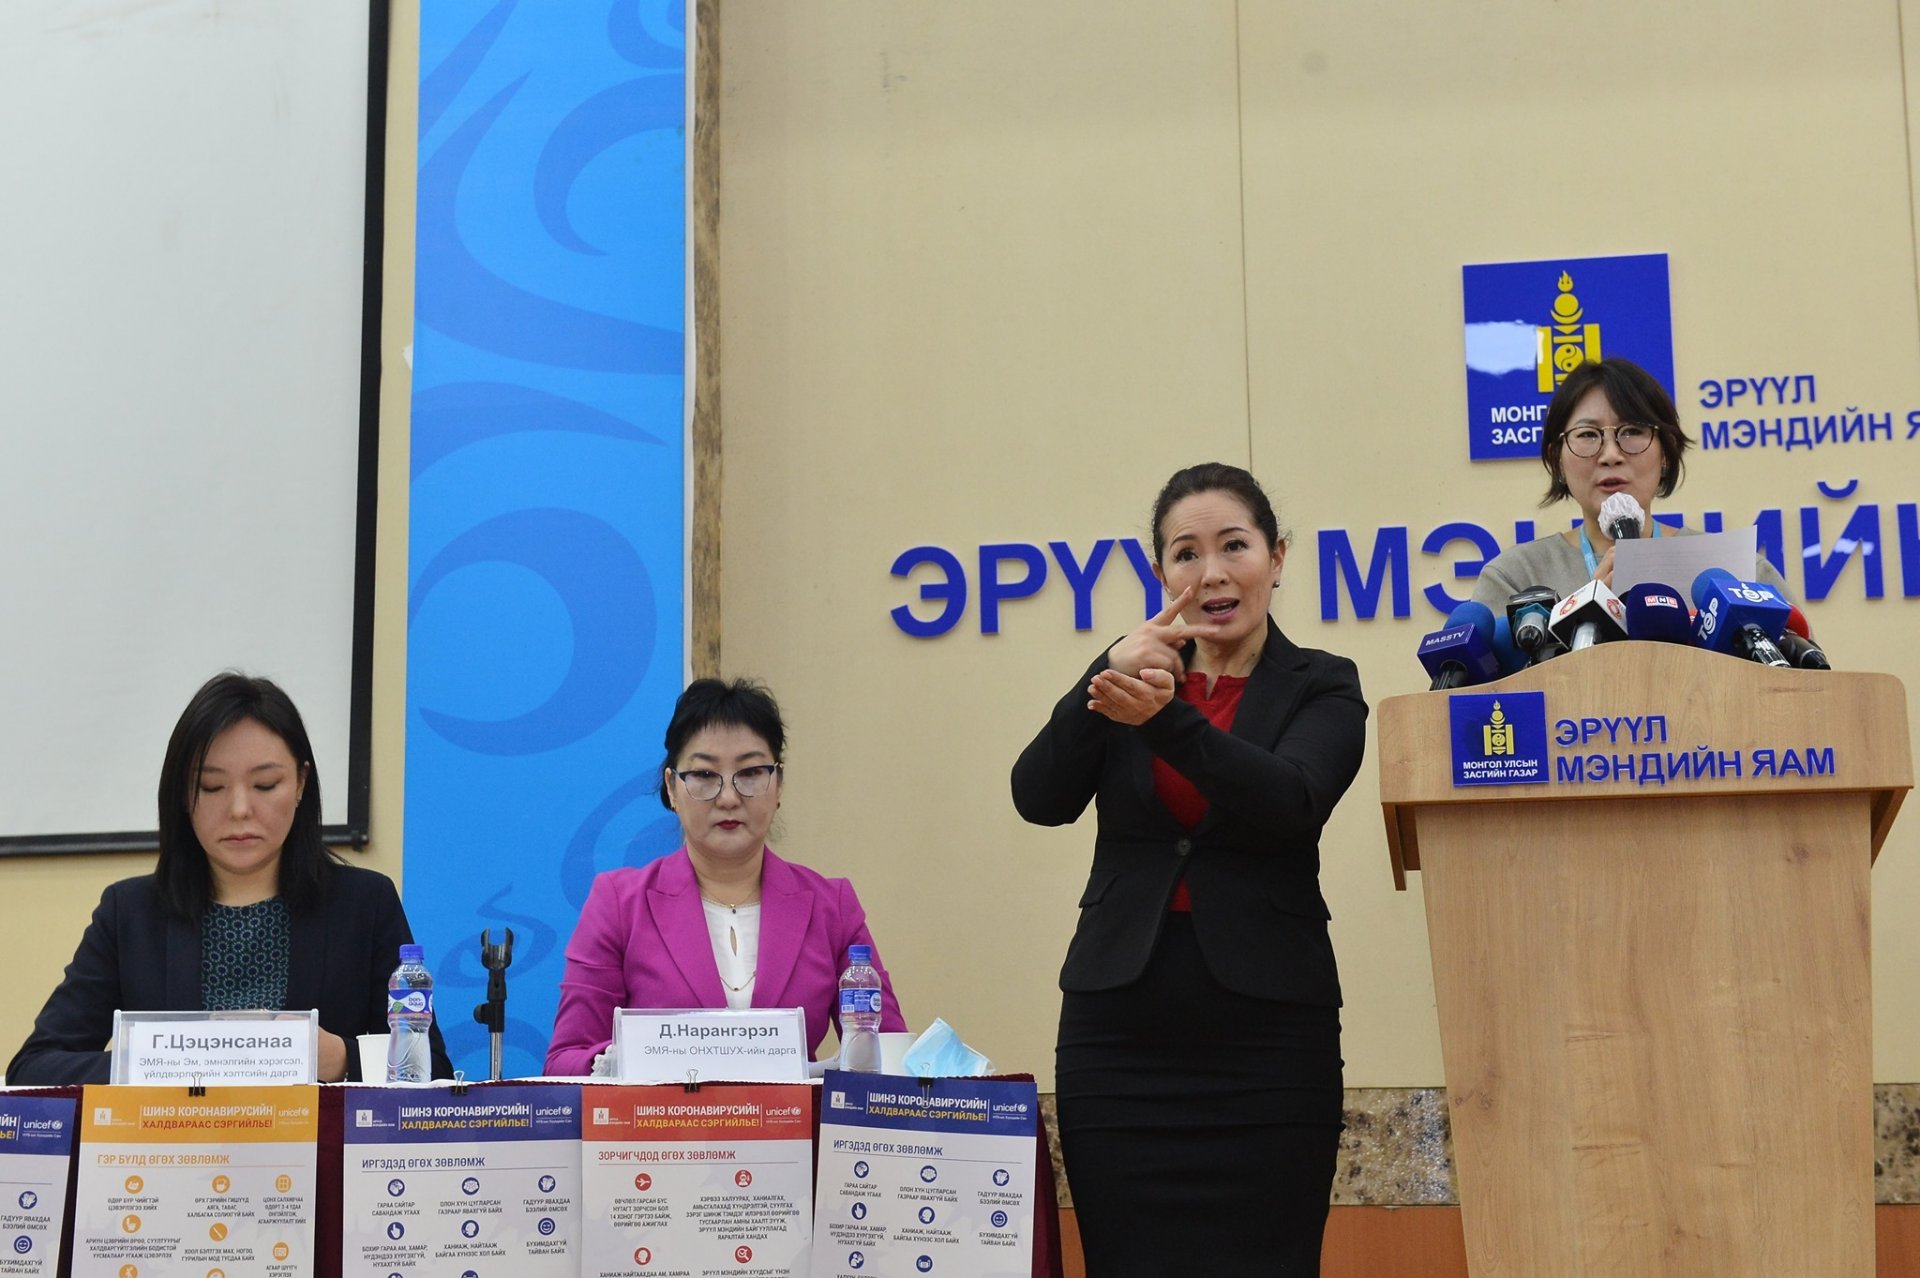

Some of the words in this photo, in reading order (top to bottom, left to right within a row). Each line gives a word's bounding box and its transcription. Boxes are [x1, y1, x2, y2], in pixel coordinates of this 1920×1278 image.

[1698, 374, 1816, 409] ЭРҮҮЛ
[1491, 404, 1547, 423] МОНГ
[1491, 426, 1543, 445] ЗАСГ
[1701, 406, 1893, 452] МЭНДИЙН
[889, 537, 1164, 639] ЭРҮҮ
[1555, 715, 1668, 746] ЭРҮҮЛ
[1463, 761, 1502, 770] МОНГОЛ
[1504, 759, 1538, 768] УЛСЫН
[1556, 745, 1742, 786] МЭНДИЙН
[1752, 747, 1836, 778] ЯАМ
[1464, 769, 1507, 779] ЗАСГИЙН
[1508, 769, 1538, 777] ГАЗАР
[659, 1024, 779, 1040] Д.Нарангэрэл
[152, 1034, 293, 1051] Г.Цэцэнсанаа
[644, 1046, 687, 1055] ЭМЯ-ны
[689, 1046, 766, 1055] ОНХТШУХ-ийн
[768, 1047, 797, 1056] дарга
[139, 1058, 181, 1066] ЭМЯ-ны
[204, 1057, 256, 1066] эмнэлгийн
[223, 1069, 268, 1078] хэлтсийн
[270, 1070, 298, 1079] дарга
[869, 1092, 896, 1104] ШИНЭ
[898, 1094, 987, 1109] КОРОНАВИРУСИЙН
[993, 1103, 1018, 1112] unicef
[142, 1106, 176, 1117] ШИНЭ
[178, 1103, 273, 1117] КОРОНАВИРУСИЙН
[278, 1108, 301, 1117] unicef
[401, 1106, 432, 1118] ШИНЭ
[434, 1103, 529, 1118] КОРОНАВИРУСИЙН
[536, 1106, 562, 1116] unicef
[636, 1105, 666, 1116] ШИНЭ
[668, 1102, 760, 1116] КОРОНАВИРУСИЙН
[766, 1106, 791, 1116] unicef
[869, 1106, 928, 1118] ХАЛДВАРААС
[929, 1108, 987, 1121] СЭРГИЙЛЬЕ!
[23, 1120, 52, 1129] unicef
[142, 1119, 211, 1130] ХАЛДВАРААС
[213, 1118, 273, 1129] СЭРГИЙЛЬЕ!
[401, 1119, 467, 1131] ХАЛДВАРААС
[469, 1117, 529, 1128] СЭРГИЙЛЬЕ!
[636, 1118, 699, 1129] ХАЛДВАРААС
[700, 1116, 760, 1127] СЭРГИЙЛЬЕ!
[833, 1140, 871, 1153] ИРГЭДЭД
[873, 1143, 894, 1153] ӨГӨХ
[896, 1145, 943, 1156] ЗӨВЛӨМЖ
[97, 1154, 116, 1164] ГЭР
[118, 1154, 146, 1166] БҮЛД
[149, 1154, 175, 1164] ӨГӨХ
[177, 1154, 230, 1164] ЗӨВЛӨМЖ
[598, 1151, 659, 1162] ЗОРЧИГЧДОД
[661, 1151, 685, 1160] ӨГӨХ
[687, 1150, 736, 1160] ЗӨВЛӨМЖ
[362, 1159, 406, 1170] ИРГЭДЭД
[408, 1158, 432, 1168] ӨГӨХ
[435, 1157, 485, 1168] ЗӨВЛӨМЖ
